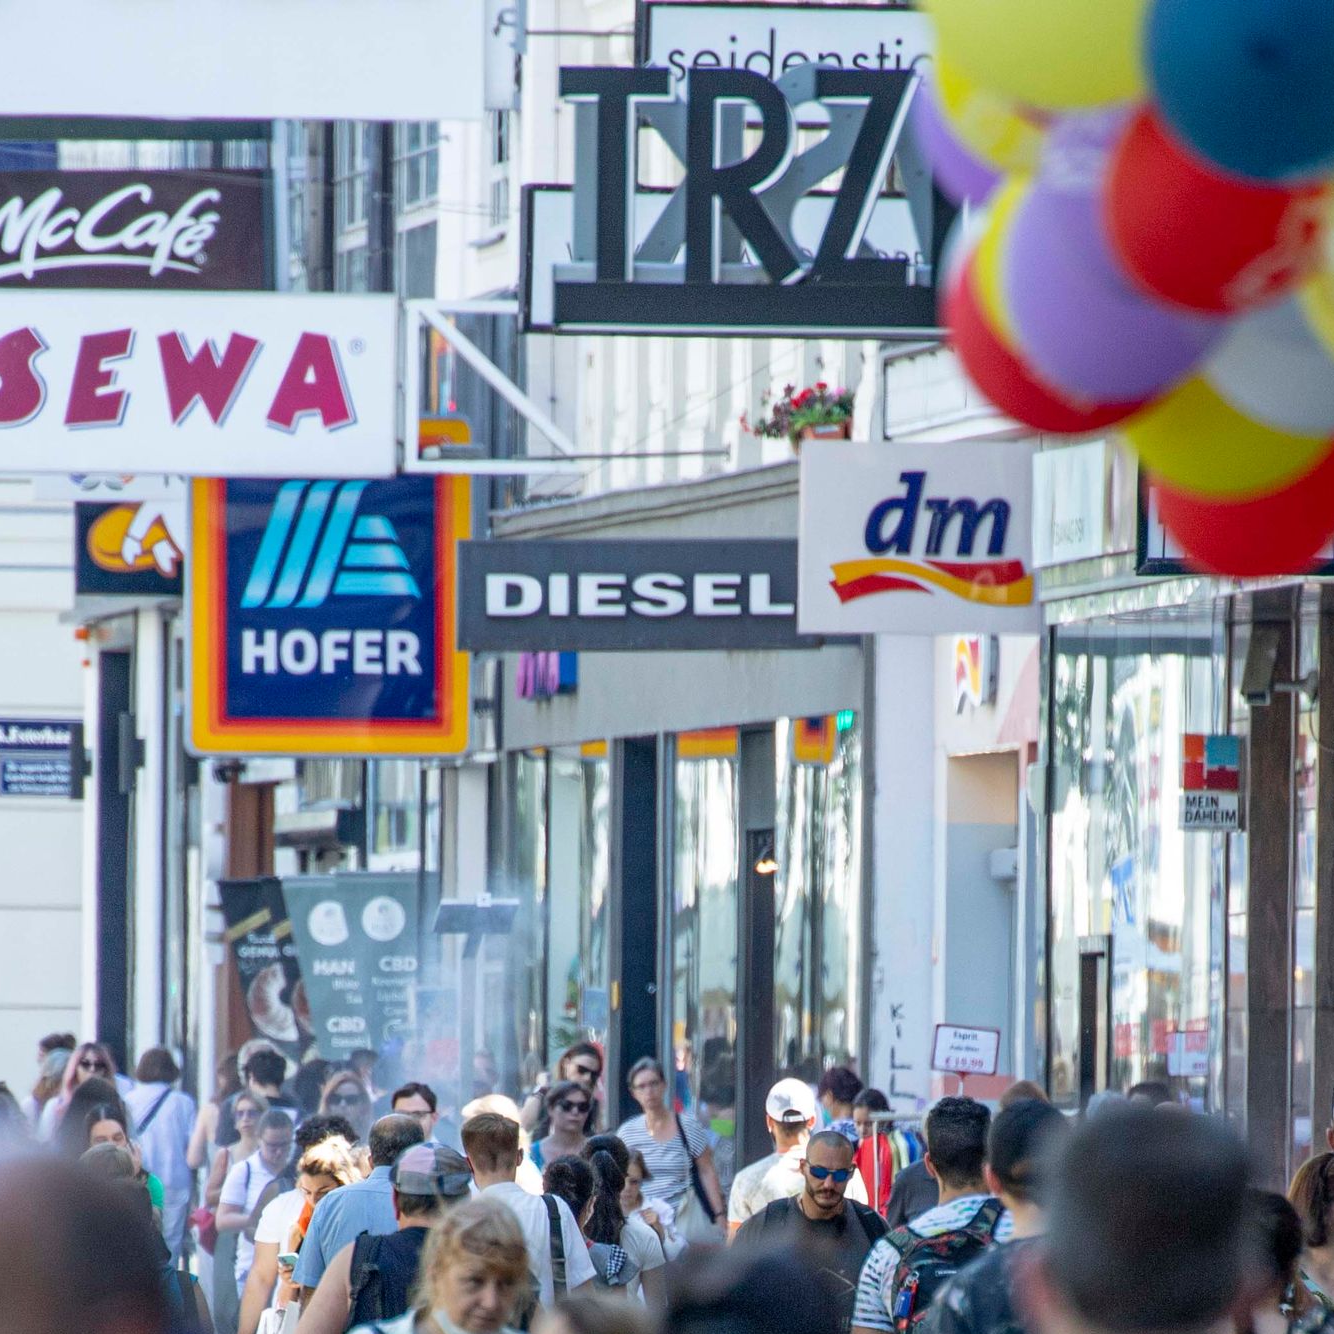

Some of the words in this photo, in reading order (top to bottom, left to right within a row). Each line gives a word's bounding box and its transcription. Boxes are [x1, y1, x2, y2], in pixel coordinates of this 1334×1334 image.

[559, 66, 919, 285] TRZ
[864, 469, 1011, 556] dm
[485, 573, 796, 617] DIESEL
[240, 629, 423, 676] HOFER
[1184, 809, 1237, 824] DAHEIM
[1185, 796, 1218, 809] MEIN
